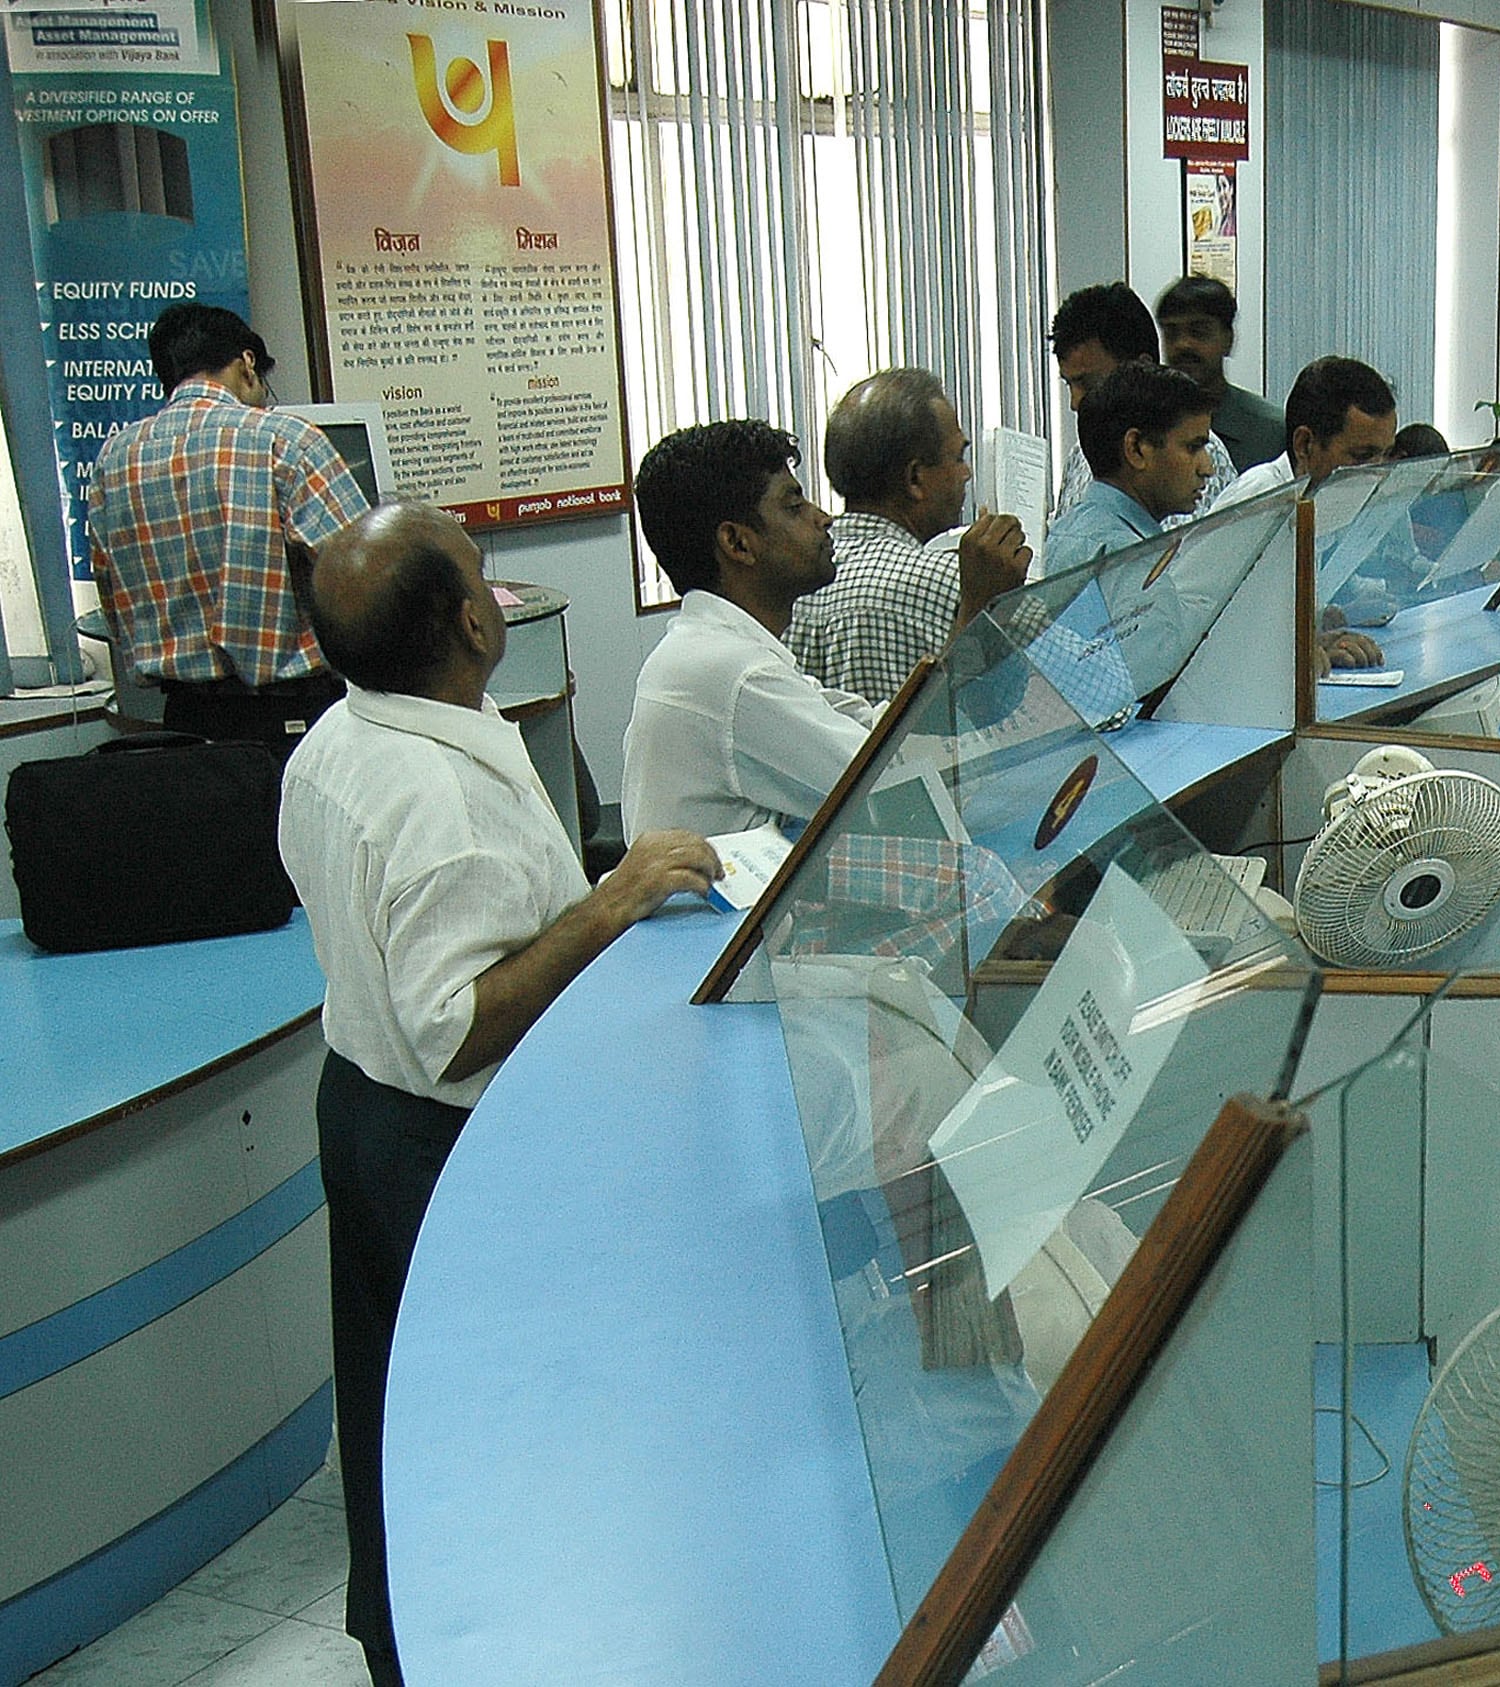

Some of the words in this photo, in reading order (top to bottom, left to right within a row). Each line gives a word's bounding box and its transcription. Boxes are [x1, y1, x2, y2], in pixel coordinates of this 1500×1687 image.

[474, 2, 488, 13] &
[494, 4, 566, 20] Mission
[15, 16, 56, 27] Asset
[58, 13, 156, 28] Management
[36, 30, 76, 42] Asset
[79, 30, 177, 44] Management
[121, 50, 153, 62] Vijaya
[155, 51, 180, 61] Bank
[25, 91, 36, 104] A
[39, 91, 118, 104] DIVERSIFIED
[121, 91, 172, 105] RANGE
[176, 92, 196, 105] OF
[86, 109, 149, 122] OPTIONS
[152, 109, 177, 122] ON
[180, 110, 219, 123] OFFER
[516, 226, 558, 250] मिशन
[53, 283, 124, 300] EQUITY
[129, 282, 197, 299] FUNDS
[59, 322, 100, 340] ELSS
[106, 322, 156, 339] SCH
[64, 360, 157, 378] INTERNAT
[527, 375, 560, 390] mission
[67, 384, 137, 401] EQUITY
[141, 383, 164, 400] FU
[382, 386, 423, 400] vision
[72, 421, 128, 438] BALA
[518, 498, 552, 517] punjab
[557, 492, 595, 509] national
[598, 489, 622, 504] bank
[1051, 779, 1085, 830] 4
